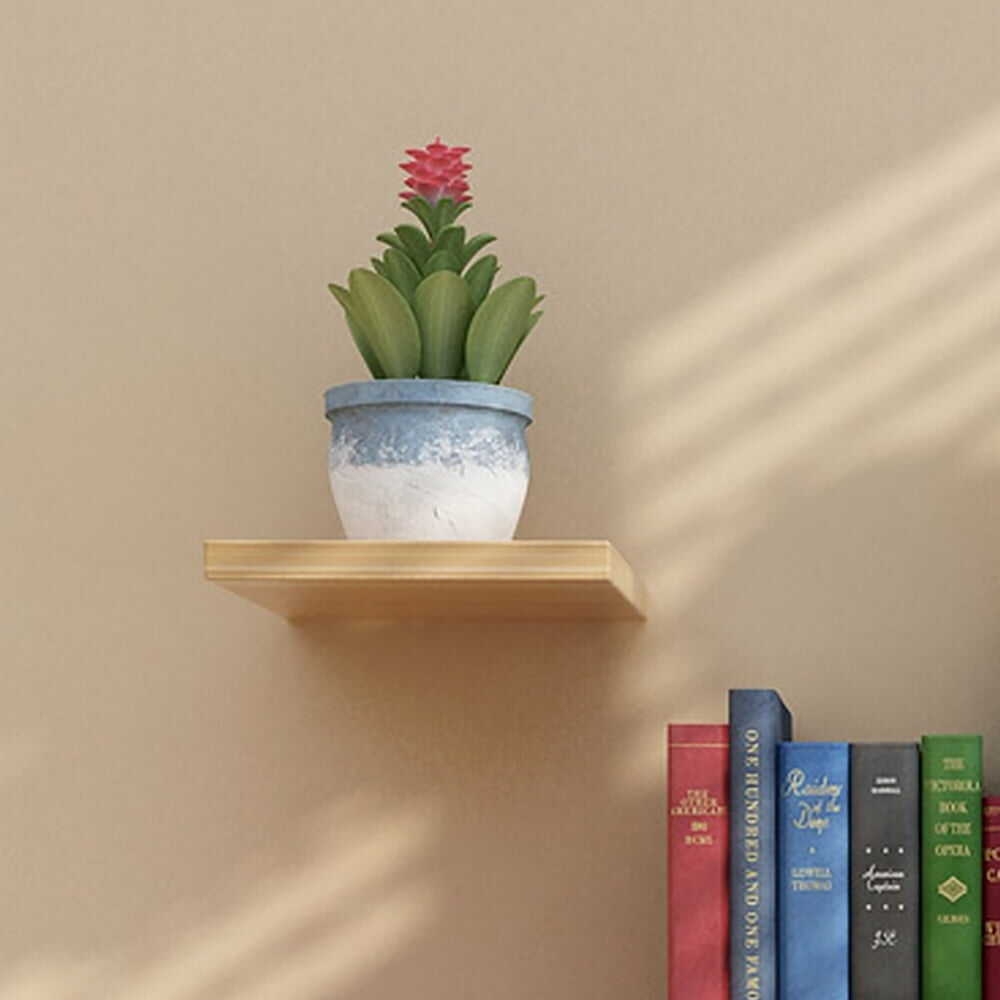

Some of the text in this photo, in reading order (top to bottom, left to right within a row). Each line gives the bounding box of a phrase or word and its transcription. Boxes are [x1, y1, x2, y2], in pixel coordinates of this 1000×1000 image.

[744, 729, 760, 767] ONE
[744, 773, 760, 862] HUNDRED
[744, 869, 760, 906] AND
[744, 911, 760, 949] ONE
